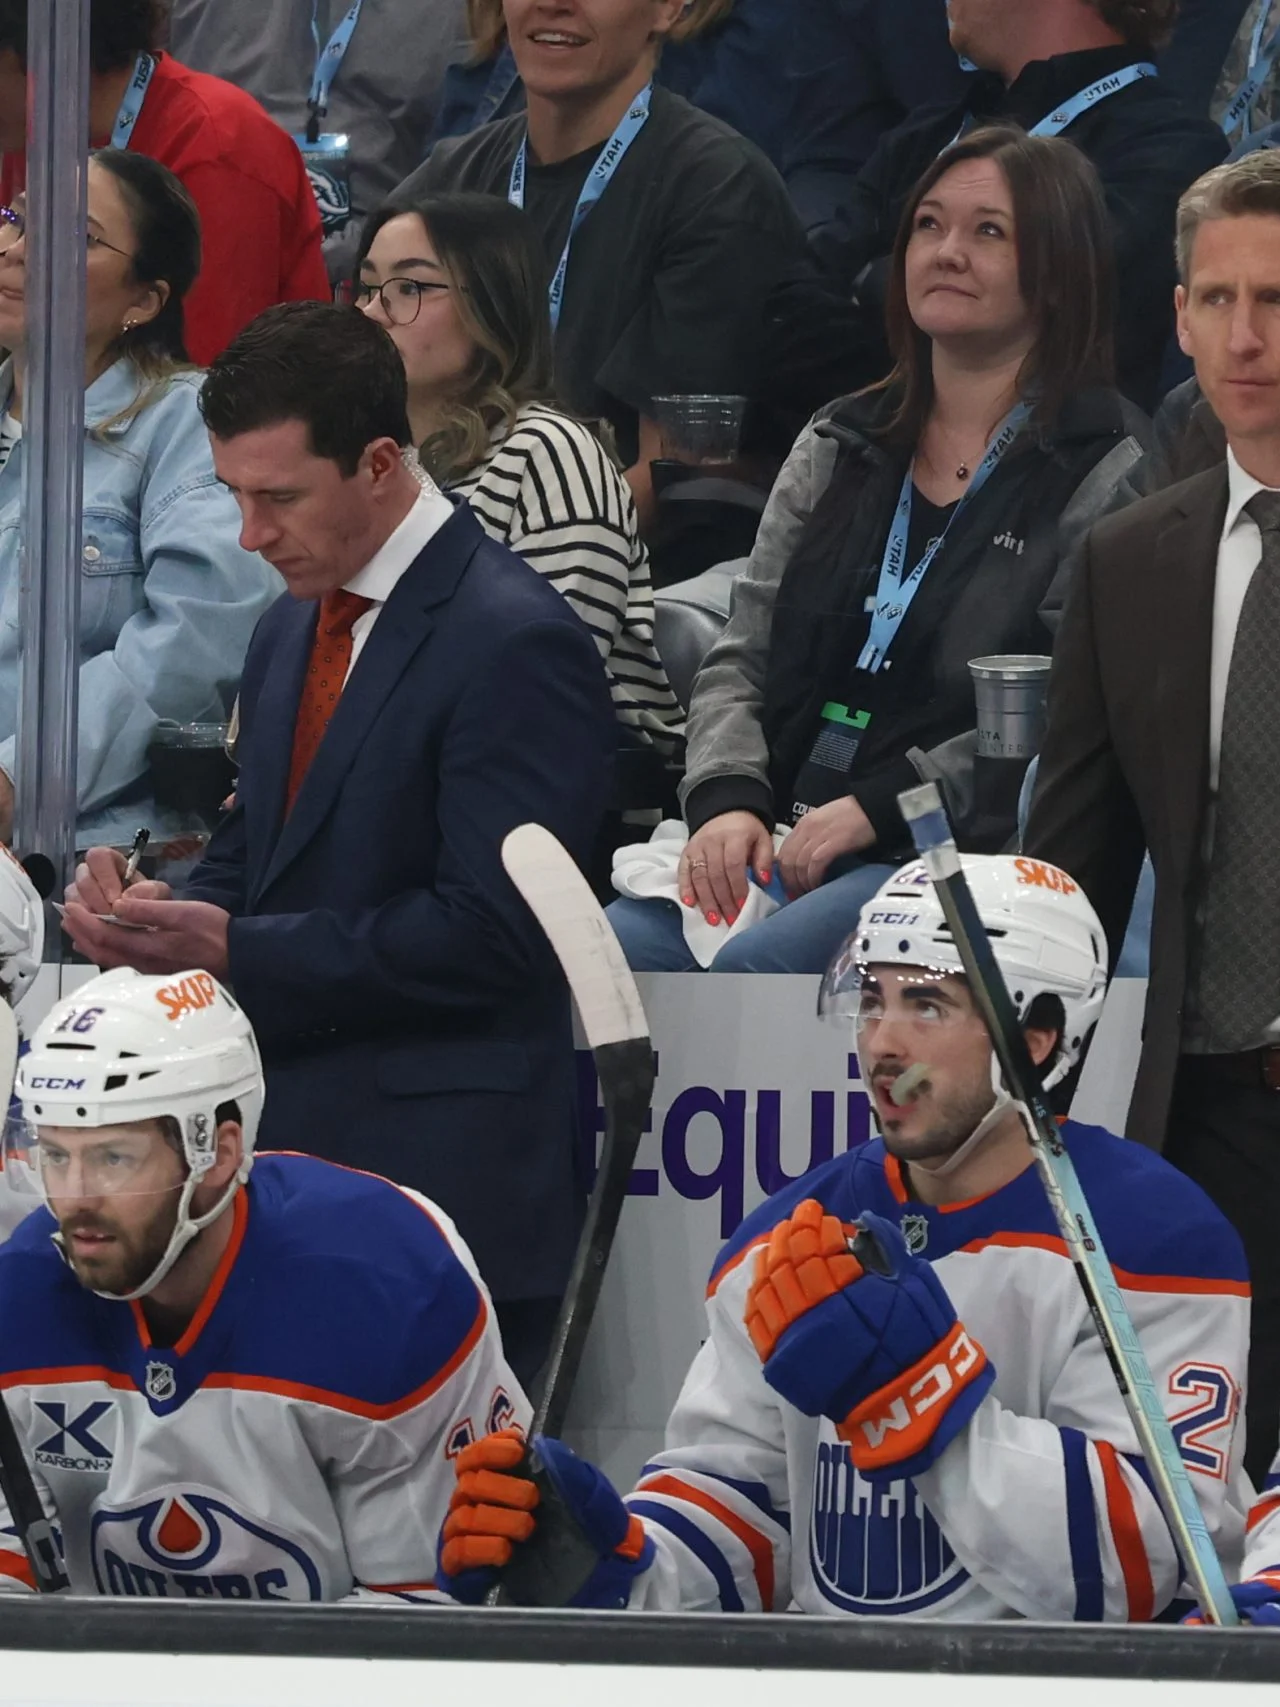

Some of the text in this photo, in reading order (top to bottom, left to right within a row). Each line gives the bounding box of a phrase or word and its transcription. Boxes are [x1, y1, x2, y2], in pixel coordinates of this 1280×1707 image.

[1083, 77, 1121, 101] UTAH
[595, 139, 623, 178] UTAH
[984, 426, 1014, 469] UTAH
[886, 535, 904, 577] UTAH
[1014, 859, 1077, 895] SKIP
[869, 912, 919, 925] CCM
[156, 974, 216, 1021] SKIP
[54, 1007, 105, 1033] 16
[30, 1077, 86, 1090] CCM
[861, 1331, 979, 1449] CCM
[1168, 1361, 1242, 1484] 2
